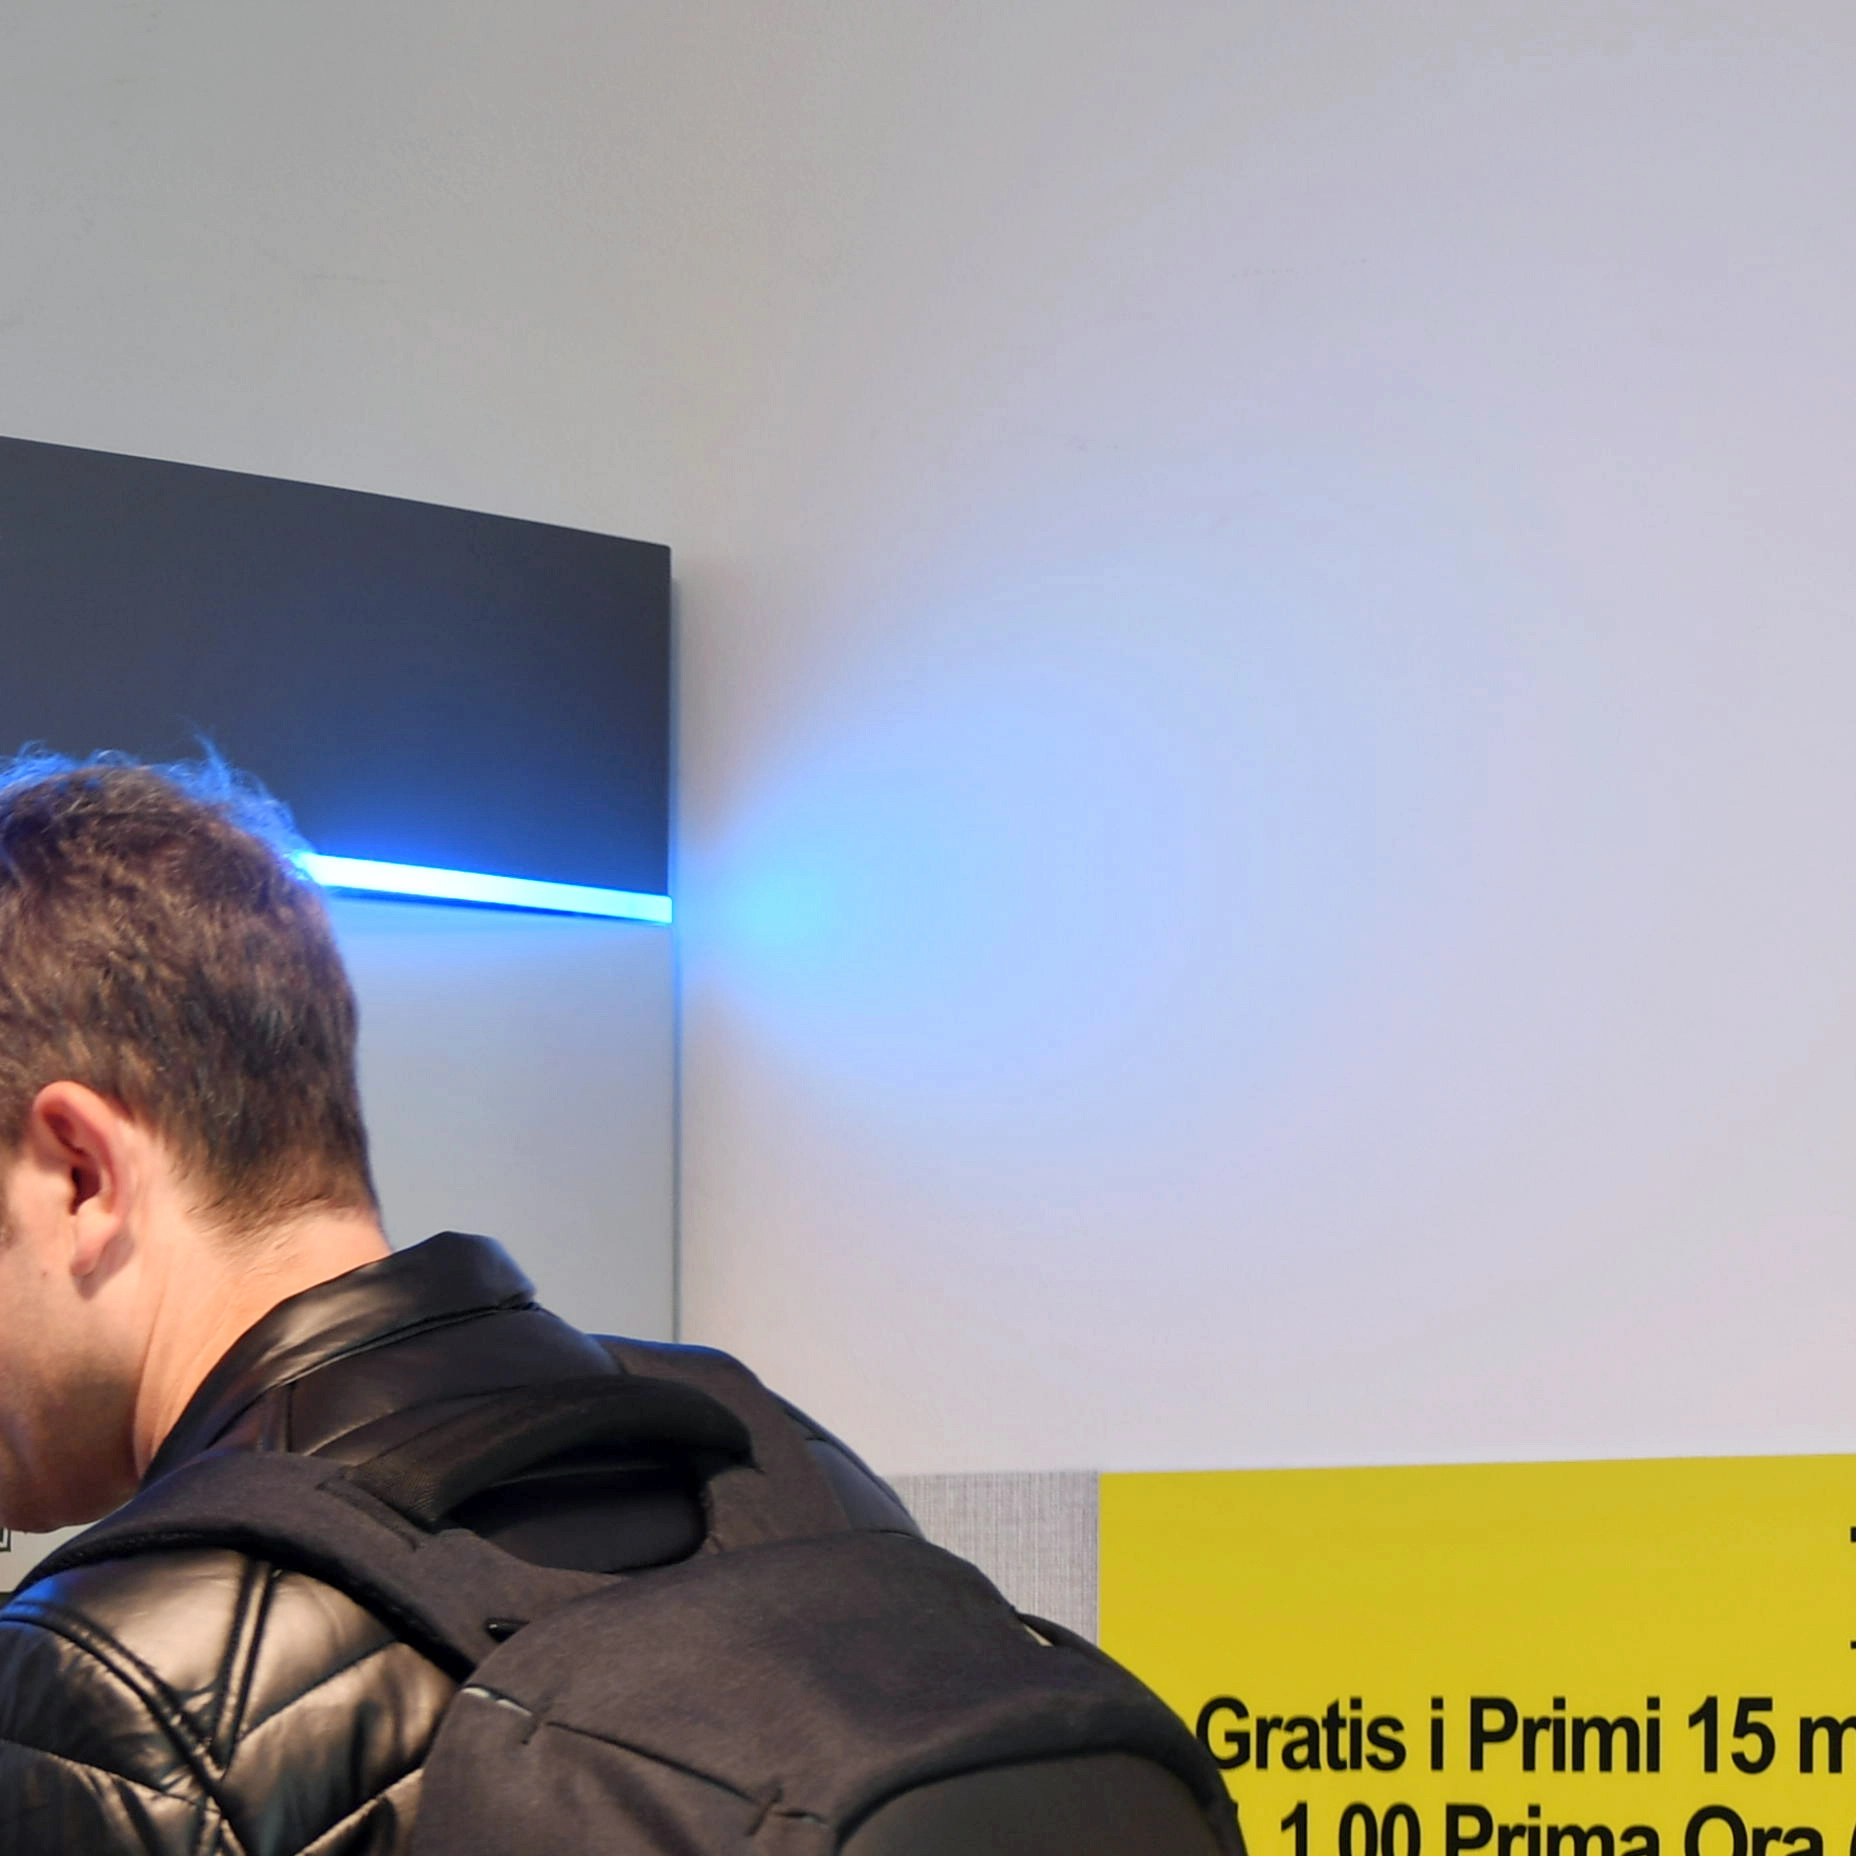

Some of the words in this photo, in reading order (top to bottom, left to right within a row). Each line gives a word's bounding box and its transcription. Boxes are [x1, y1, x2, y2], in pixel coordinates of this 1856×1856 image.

[1195, 1697, 1406, 1773] Gratis
[1430, 1697, 1444, 1772] i
[1469, 1697, 1661, 1773] Primi
[1688, 1695, 1776, 1775] 15
